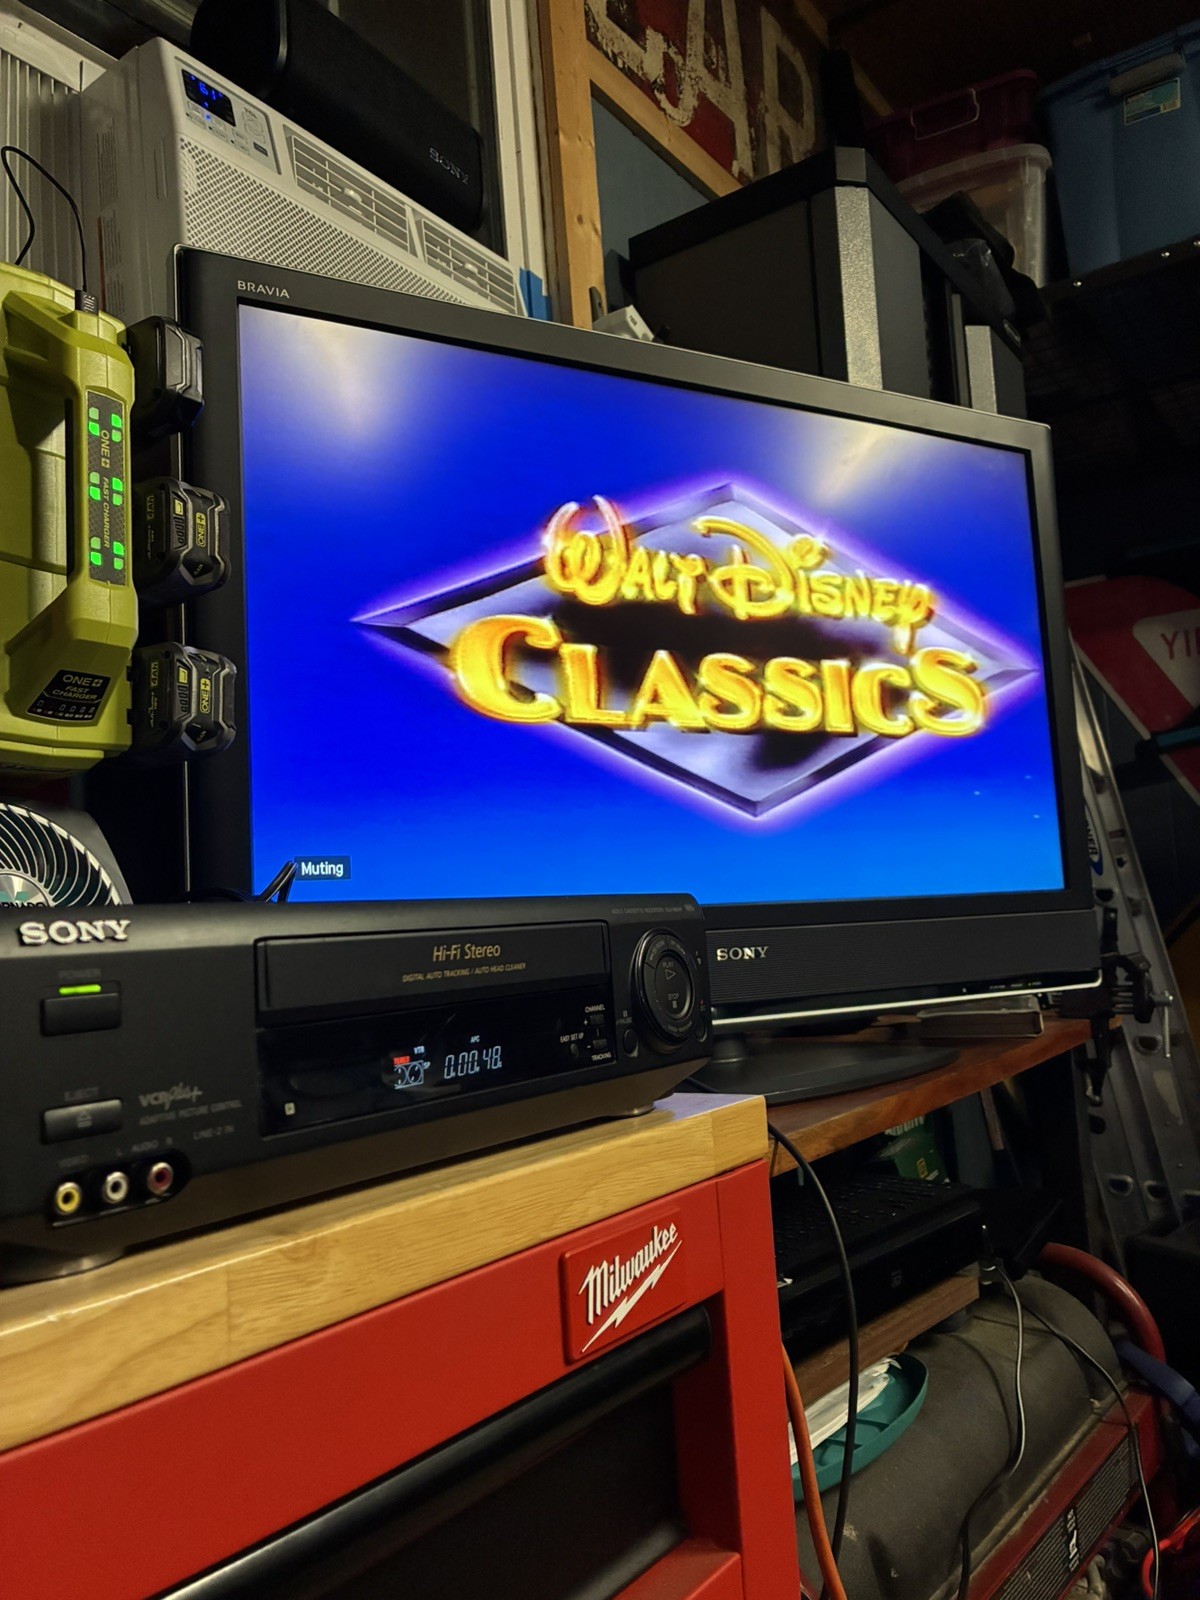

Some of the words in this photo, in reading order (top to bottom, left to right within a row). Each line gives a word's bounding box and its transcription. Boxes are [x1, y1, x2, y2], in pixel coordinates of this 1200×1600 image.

[429, 147, 469, 185] SONY
[237, 280, 290, 299] BRAVIA
[102, 503, 110, 548] CHARGER
[1160, 626, 1200, 660] YI
[446, 611, 987, 738] CLASSICS
[52, 689, 98, 700] CHARGER
[64, 685, 90, 694] FAST
[301, 860, 344, 878] Muting
[19, 918, 131, 946] SONY
[432, 944, 462, 962] Hi-Fi
[464, 943, 501, 960] Stereo
[716, 945, 769, 961] SONY
[402, 972, 424, 983] DIGITAL
[426, 970, 442, 980] AUTO
[443, 967, 470, 978] TRACKING
[474, 965, 490, 975] AUTO
[490, 964, 505, 973] HEAD
[505, 962, 527, 971] CLEANER
[584, 1003, 606, 1013] CHANNEL
[591, 1051, 612, 1061] TRACKING
[578, 1222, 678, 1325] Milwaukee
